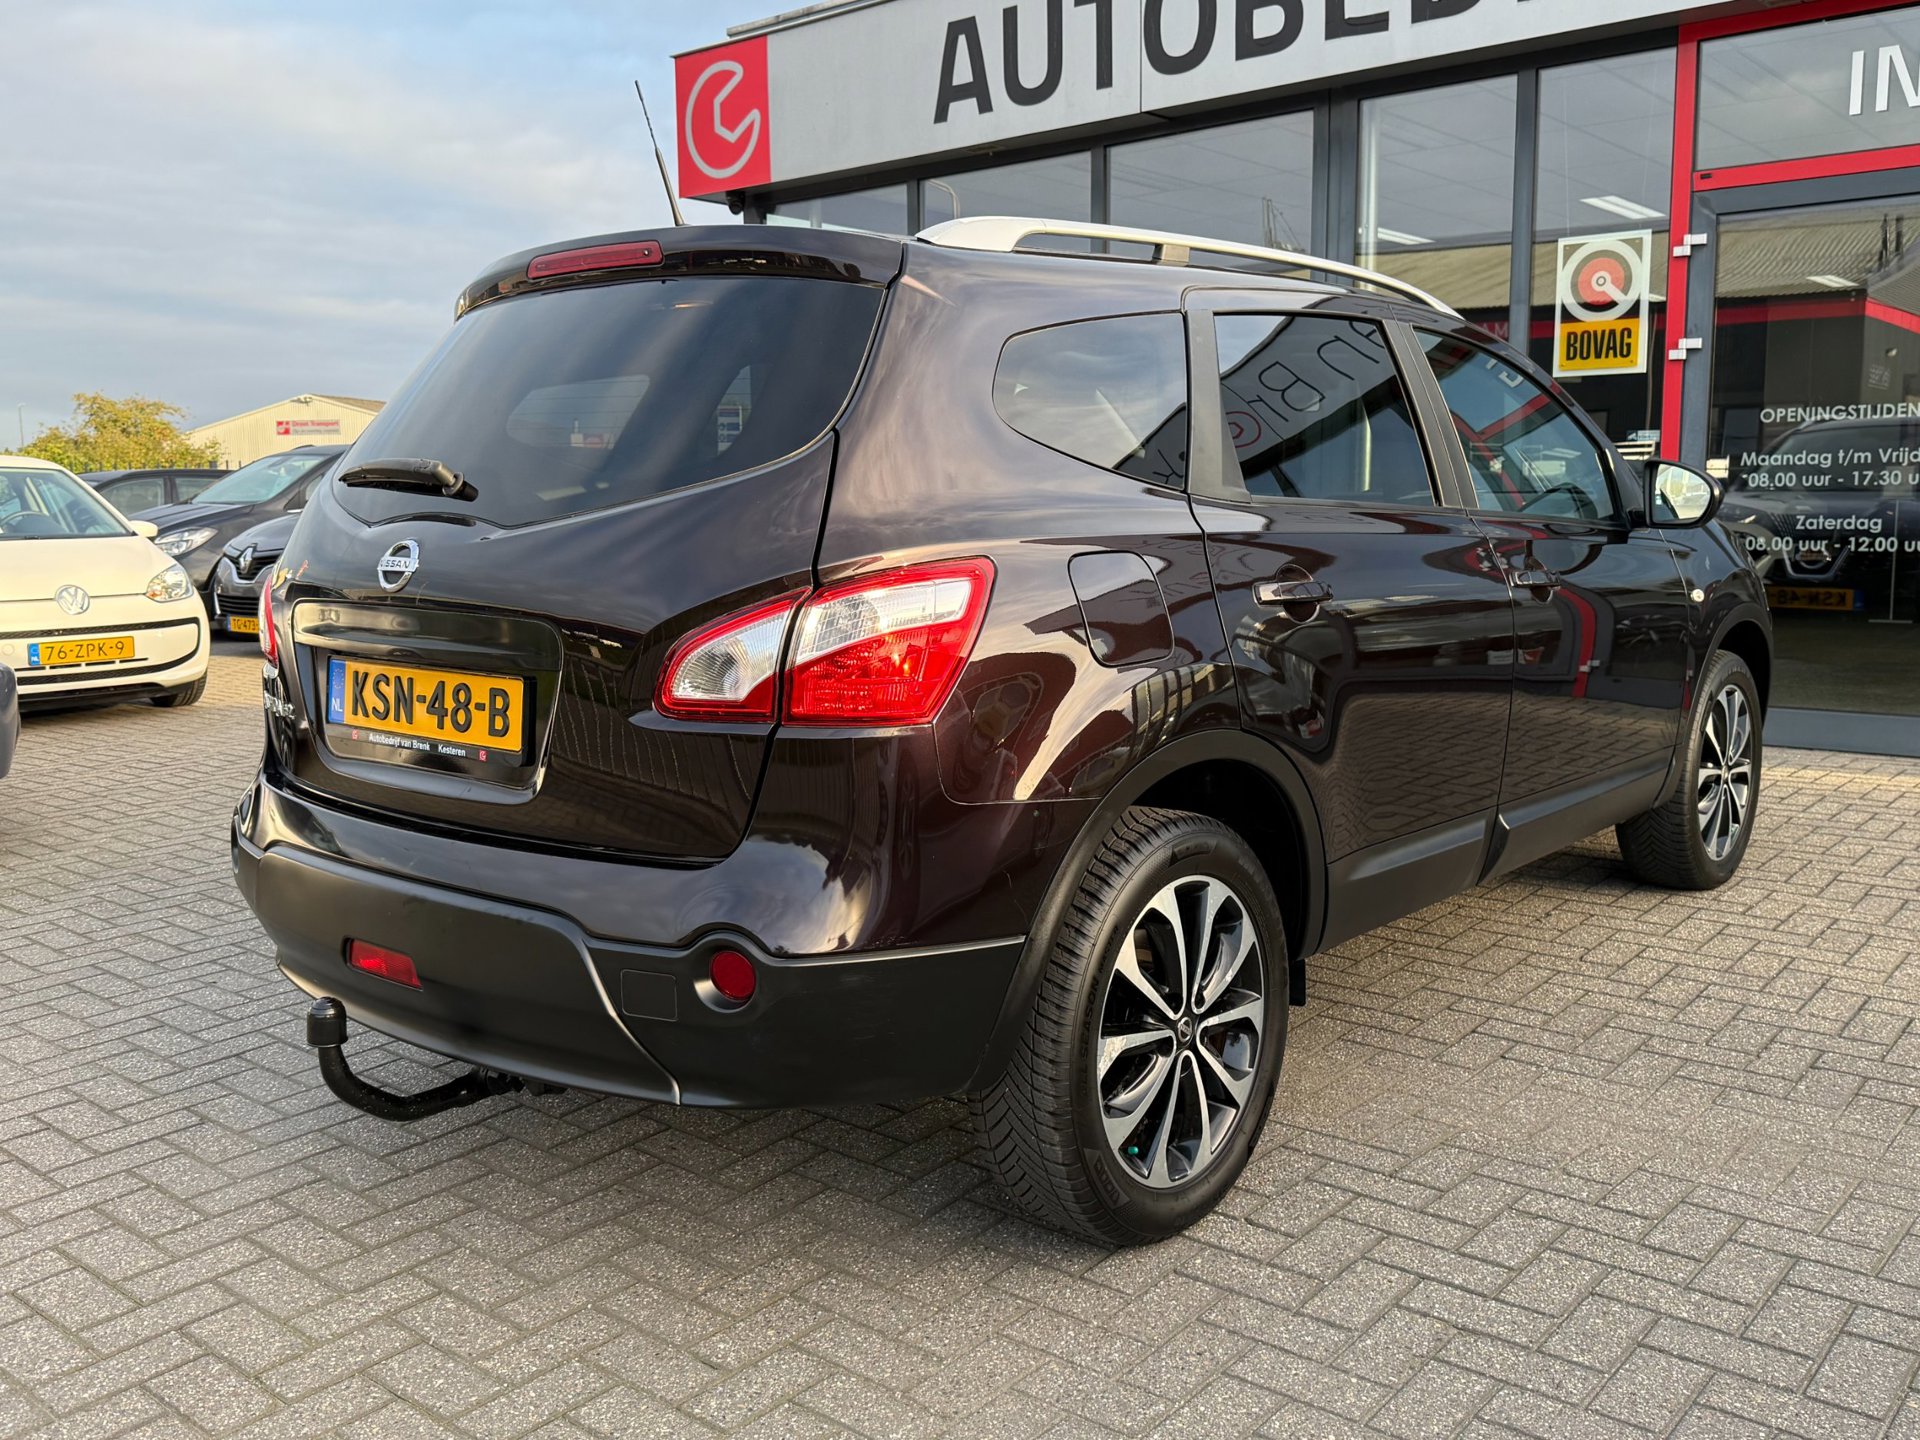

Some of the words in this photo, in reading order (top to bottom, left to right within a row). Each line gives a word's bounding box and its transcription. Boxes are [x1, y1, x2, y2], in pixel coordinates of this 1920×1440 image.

[1566, 327, 1632, 361] BOVAG
[1760, 402, 1920, 423] OPENINGSTIJDEN
[1740, 450, 1832, 468] Maandag
[1837, 449, 1872, 466] t/m
[1748, 473, 1796, 488] 08.00
[1802, 474, 1832, 486] uur
[1852, 470, 1902, 486] 17.30
[1795, 515, 1882, 533] Zaterdag
[1745, 536, 1793, 551] 08.00
[1799, 539, 1828, 551] uur
[1848, 536, 1898, 552] 12.00
[45, 640, 125, 661] 76-ZPK-9
[331, 697, 343, 712] NL
[351, 670, 511, 738] KSN-48-B
[368, 733, 400, 748] Autobedrijf
[401, 740, 412, 749] van
[412, 740, 431, 751] Brenk
[438, 744, 466, 757] Kesteren
